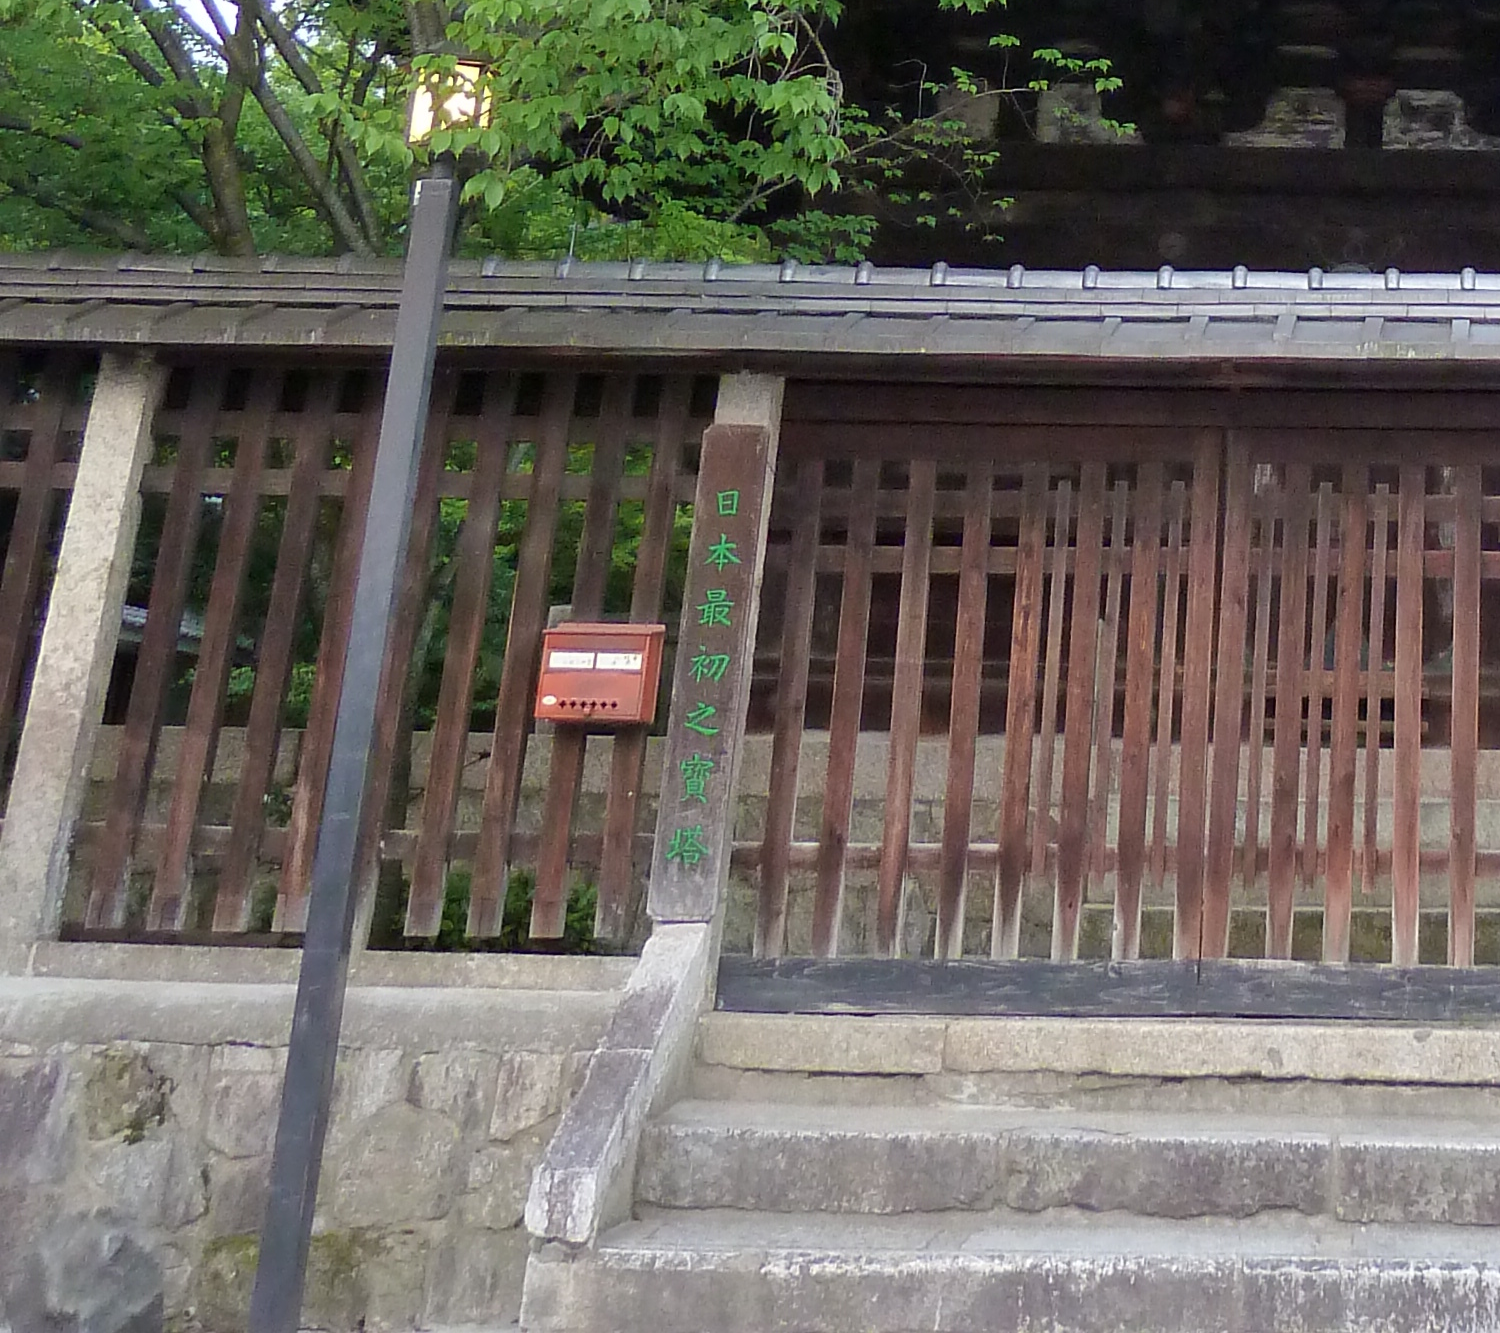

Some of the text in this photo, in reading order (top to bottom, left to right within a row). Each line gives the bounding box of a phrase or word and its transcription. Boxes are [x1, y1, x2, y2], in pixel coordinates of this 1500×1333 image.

[666, 490, 741, 864] 日本最初之寶塔
